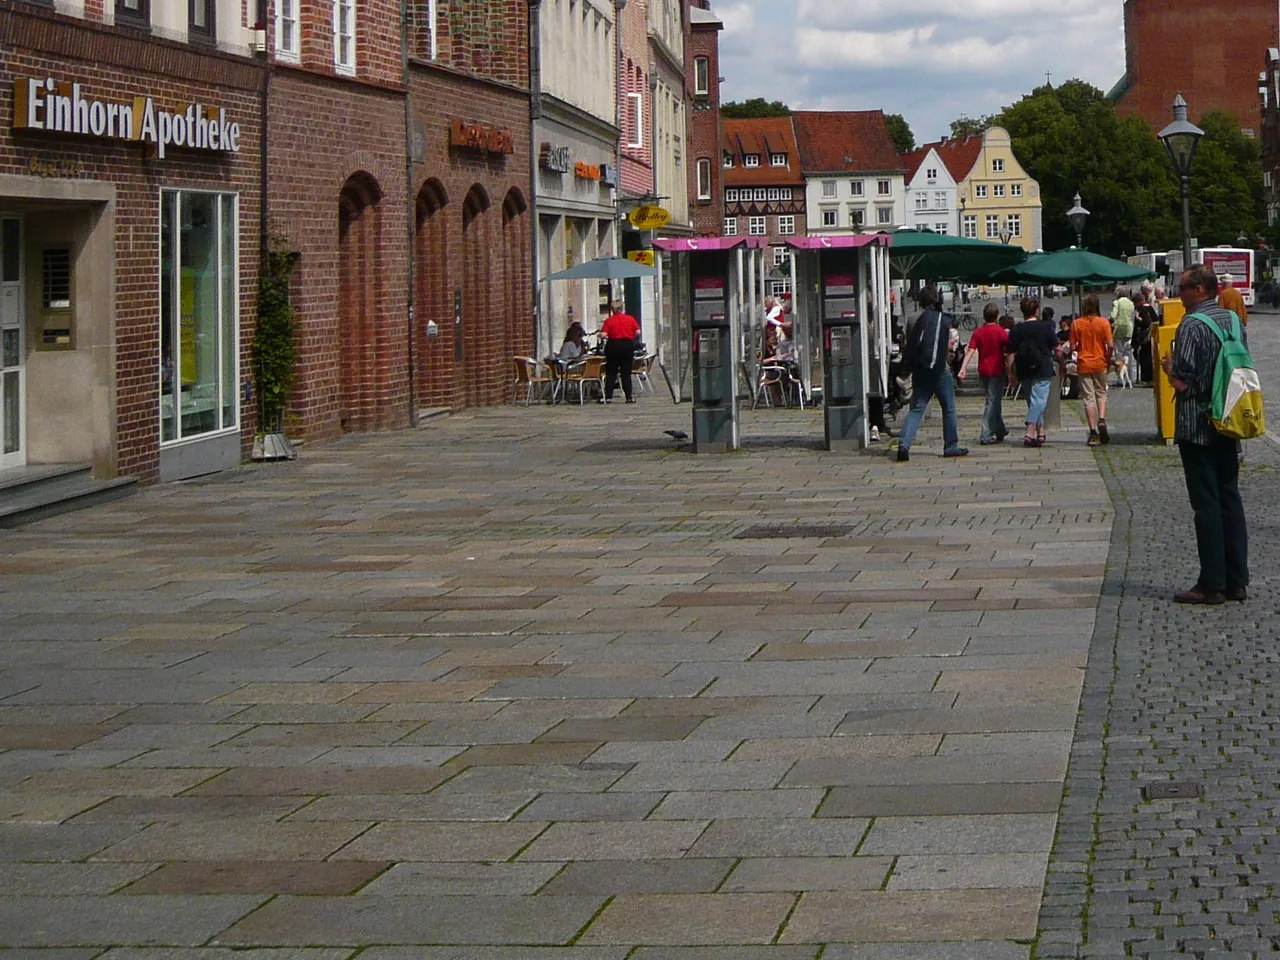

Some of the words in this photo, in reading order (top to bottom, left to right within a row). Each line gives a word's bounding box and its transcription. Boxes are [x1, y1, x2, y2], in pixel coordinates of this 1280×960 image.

[27, 77, 133, 139] Einhorn
[141, 97, 240, 159] Apotheke
[633, 211, 668, 222] Medley
